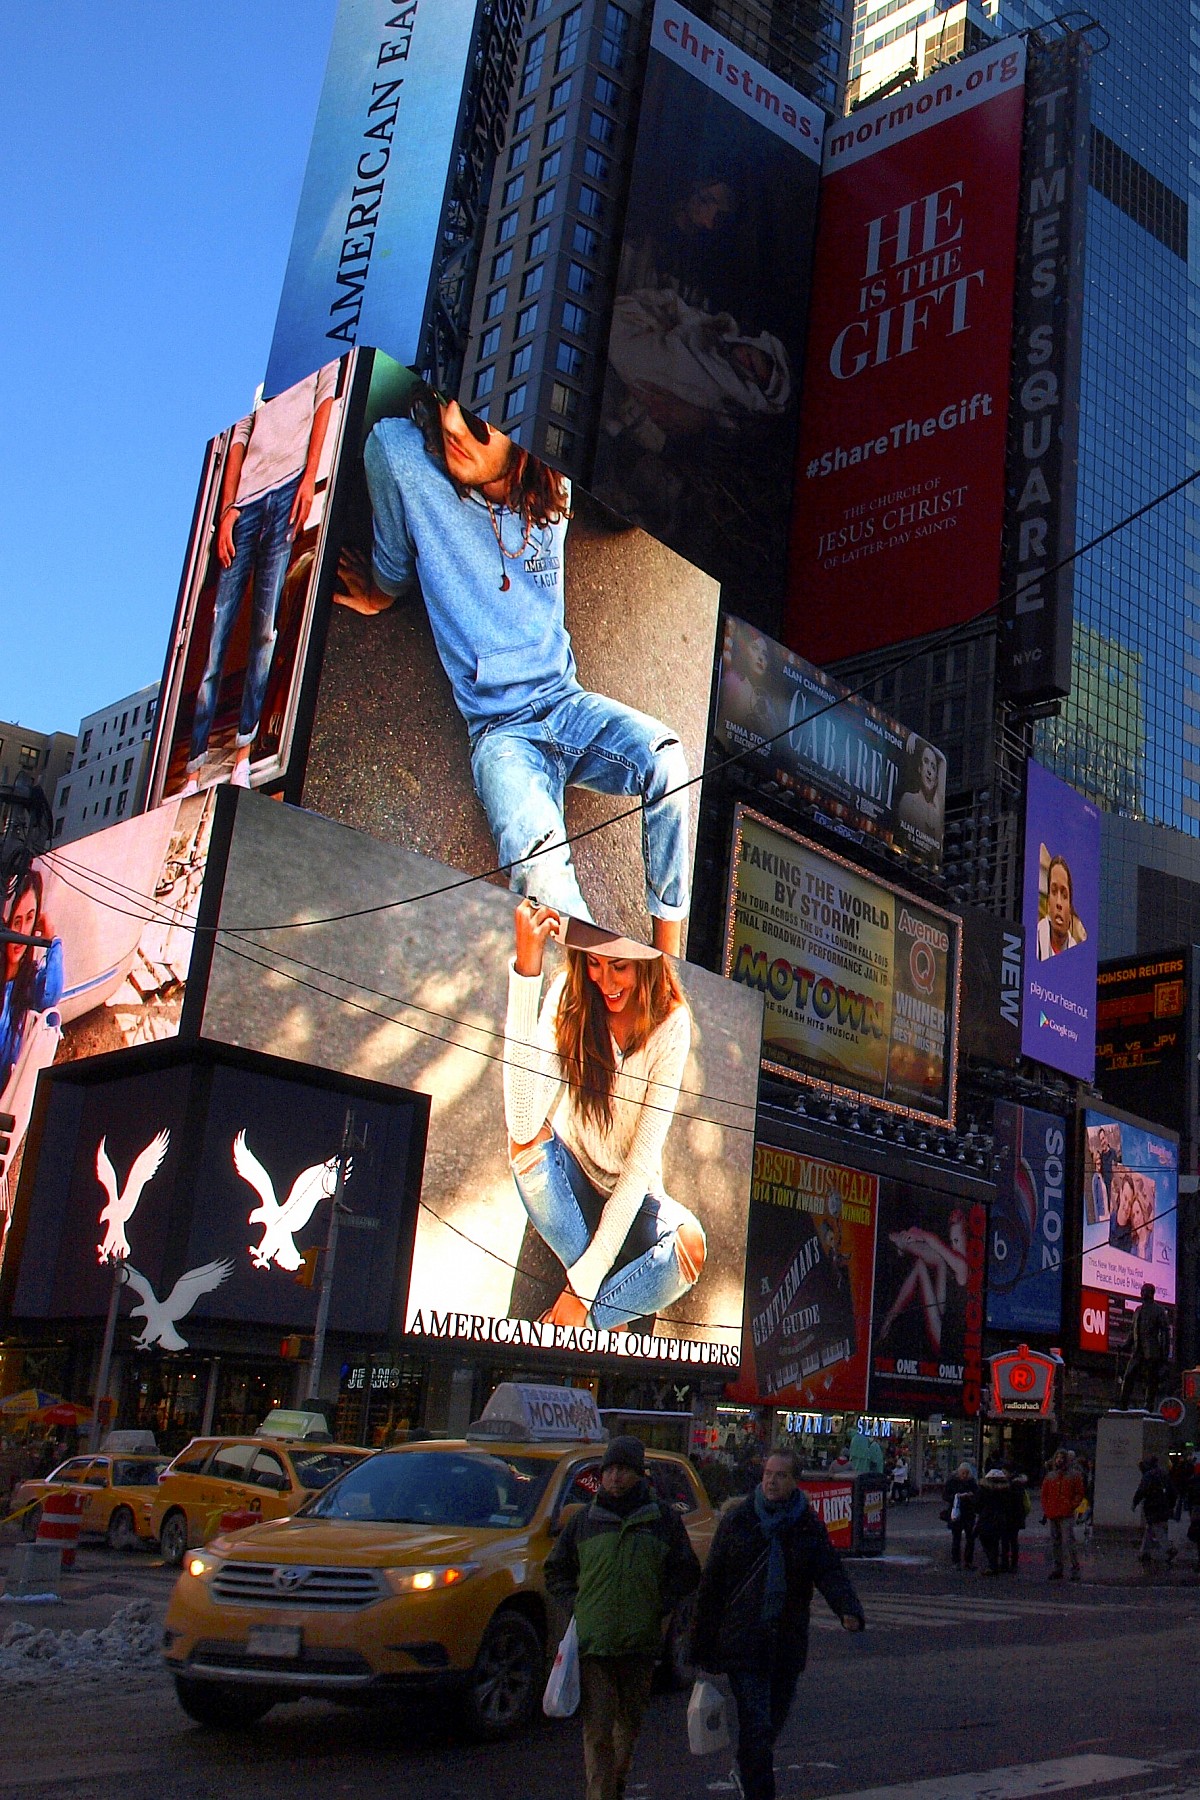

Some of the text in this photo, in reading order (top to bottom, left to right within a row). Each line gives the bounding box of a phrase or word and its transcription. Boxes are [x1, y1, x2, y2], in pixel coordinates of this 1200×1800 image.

[662, 16, 821, 144] christmas.
[830, 51, 1019, 157] mormon.org
[326, 0, 418, 346] AMERICAN EA
[1029, 87, 1068, 299] TIMES
[860, 181, 963, 281] HE
[859, 246, 961, 313] IS THE
[829, 269, 984, 380] GIFT
[806, 393, 992, 479] #ShareTheGift
[1015, 324, 1059, 615] SQUARE
[817, 486, 968, 559] JESUS CHRIST
[843, 477, 941, 520] THE CHURCH OF
[824, 516, 957, 570] OF LATTER-DAY SAINTS
[782, 666, 803, 684] ALAN
[788, 689, 899, 811] CABARET
[864, 717, 903, 750] EMMA STONE
[741, 841, 889, 930] TAKING THE WORLD
[774, 881, 859, 940] BY STORM!
[750, 895, 769, 911] TOUR
[771, 905, 799, 926] ACROSS
[800, 918, 813, 933] THE
[814, 925, 823, 937] US
[831, 933, 858, 952] LONDON
[858, 944, 873, 962] FALL
[762, 921, 807, 949] BROADWAY
[808, 941, 862, 977] PERFORMANCE
[864, 965, 877, 983] JAN
[898, 908, 949, 953] Avenue
[732, 944, 885, 1038] MOTOWN
[909, 940, 936, 995] Q
[1000, 932, 1022, 1028] NEW
[1097, 959, 1184, 985] HOMSON REUTERS
[777, 1005, 805, 1022] SMASH
[807, 1016, 825, 1031] HITS
[827, 1025, 860, 1045] MUSICAL
[895, 990, 945, 1028] WINNER
[1030, 981, 1089, 1019] play your heart out
[1049, 1018, 1079, 1042] Google play
[1153, 1032, 1176, 1047] JPY
[753, 1149, 795, 1184] BEST
[772, 1186, 795, 1208] TONY
[797, 1190, 825, 1215] AWARD
[842, 1206, 871, 1227] WINNER
[1042, 1127, 1064, 1272] SOLO 2
[752, 1236, 820, 1346] GENTLEMAN'S
[760, 1276, 771, 1296] A
[1113, 1274, 1126, 1287] Love
[410, 1308, 543, 1347] AMERICAN
[553, 1322, 619, 1354] EAGLE
[625, 1331, 740, 1367] OUTFITTERS
[782, 1303, 821, 1337] GUIDE
[1082, 1307, 1106, 1336] CNN
[896, 1358, 918, 1375] ONE
[939, 1363, 965, 1380] ONLY
[785, 1411, 892, 1438] GRAND SLAM
